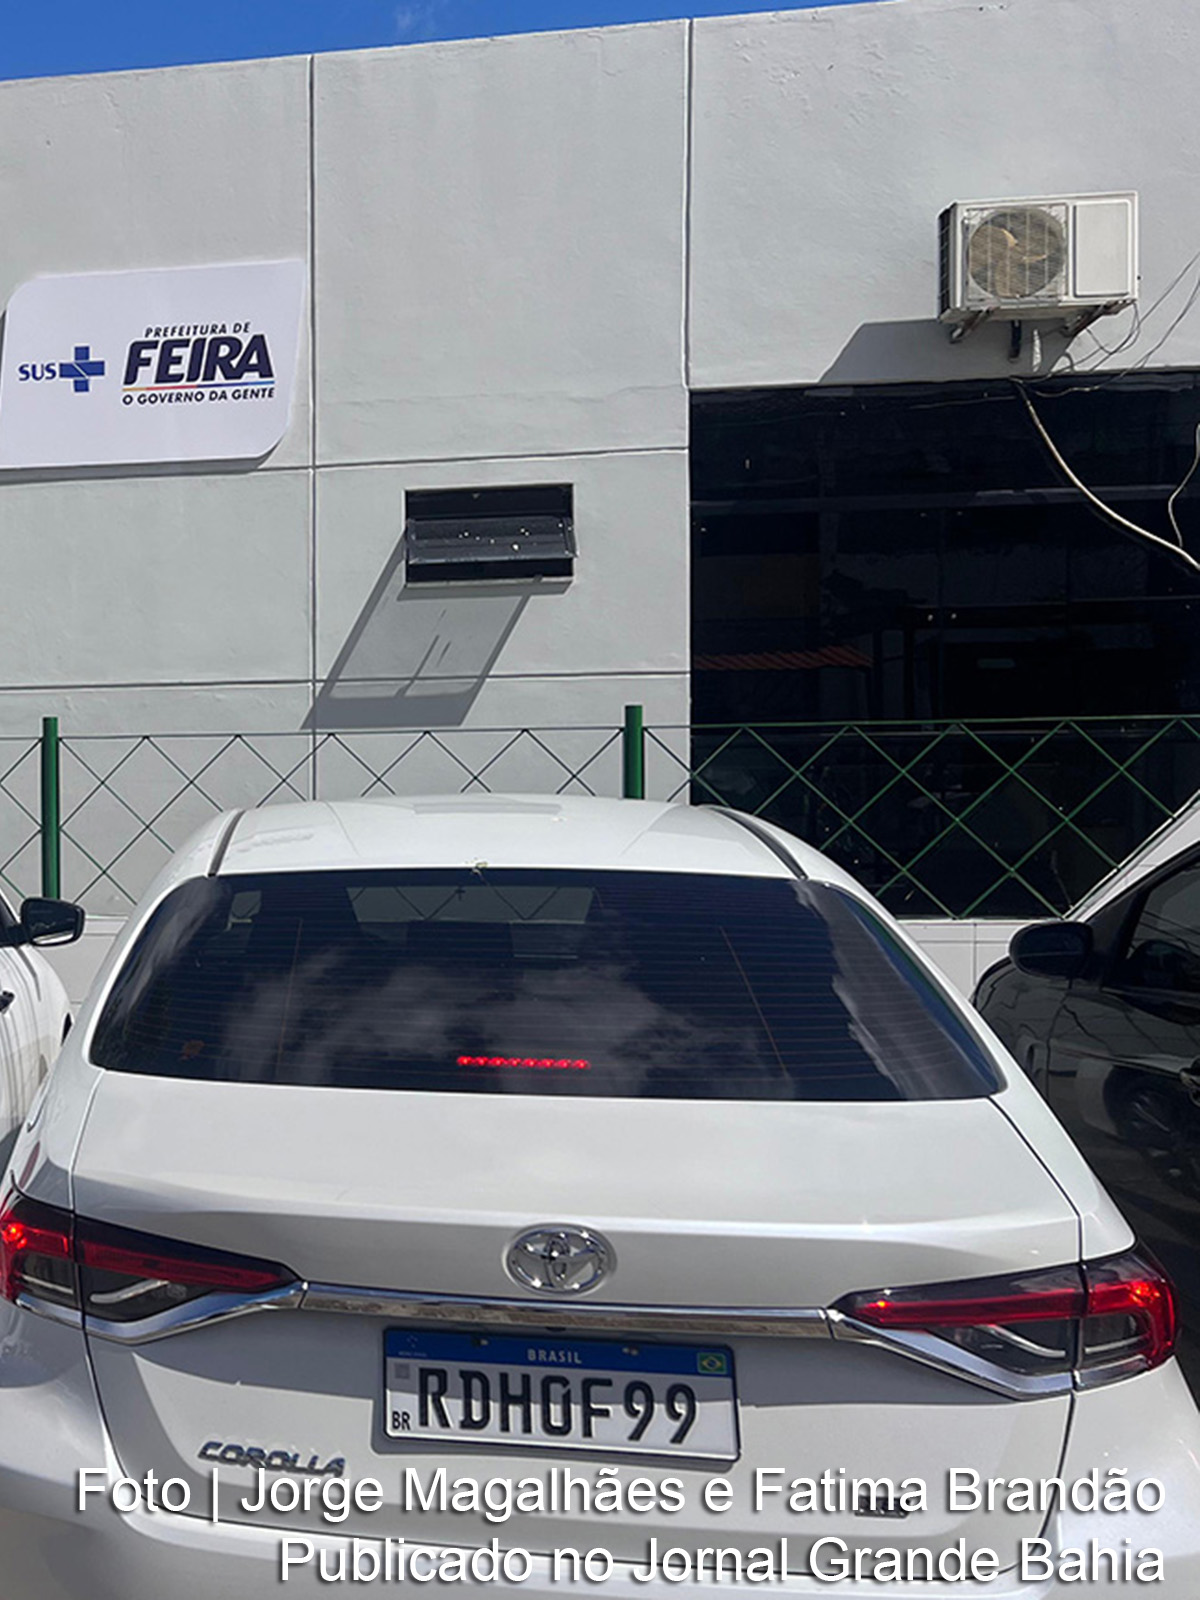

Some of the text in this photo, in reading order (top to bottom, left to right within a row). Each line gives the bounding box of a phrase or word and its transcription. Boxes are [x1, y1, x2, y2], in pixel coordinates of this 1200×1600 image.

[144, 321, 251, 339] PREFEITURA DE
[123, 334, 274, 386] FEIRA
[17, 362, 57, 382] SUS
[122, 386, 275, 406] O GOVERNO DA GENTE
[526, 1348, 583, 1365] BRASIL
[391, 1409, 411, 1432] BR
[197, 1440, 346, 1477] COROLLA
